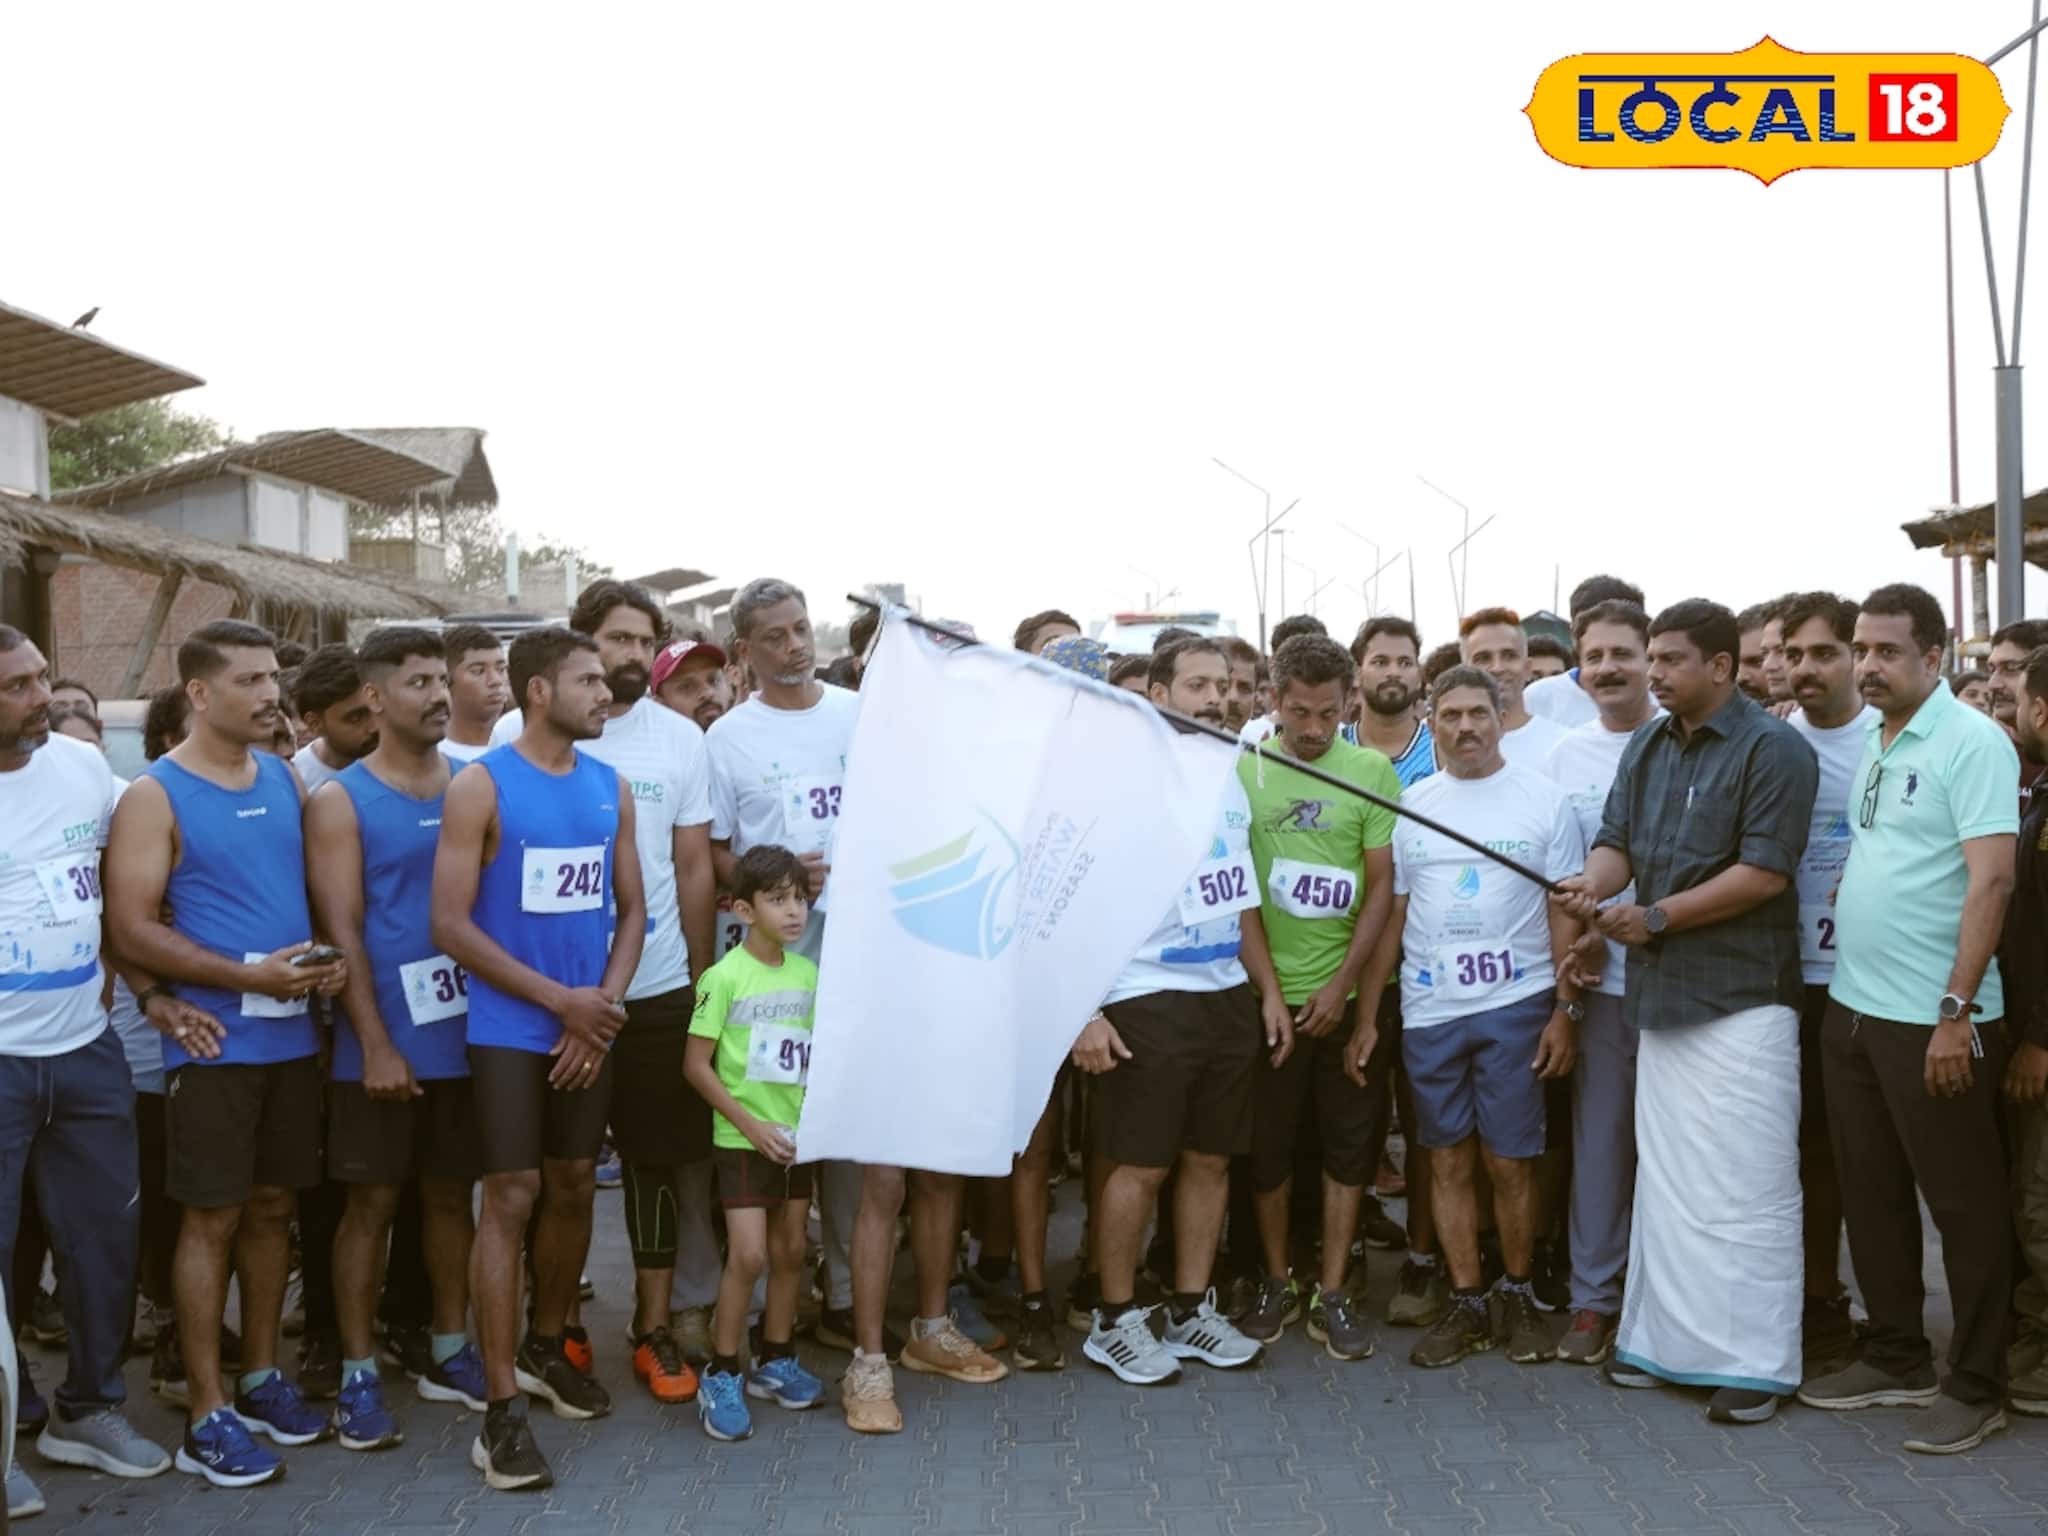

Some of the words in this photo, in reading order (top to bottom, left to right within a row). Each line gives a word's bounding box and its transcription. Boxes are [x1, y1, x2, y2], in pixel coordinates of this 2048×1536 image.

[556, 861, 602, 899] 242
[1198, 866, 1249, 906] 502
[1292, 874, 1353, 909] 450
[1456, 949, 1513, 986] 361
